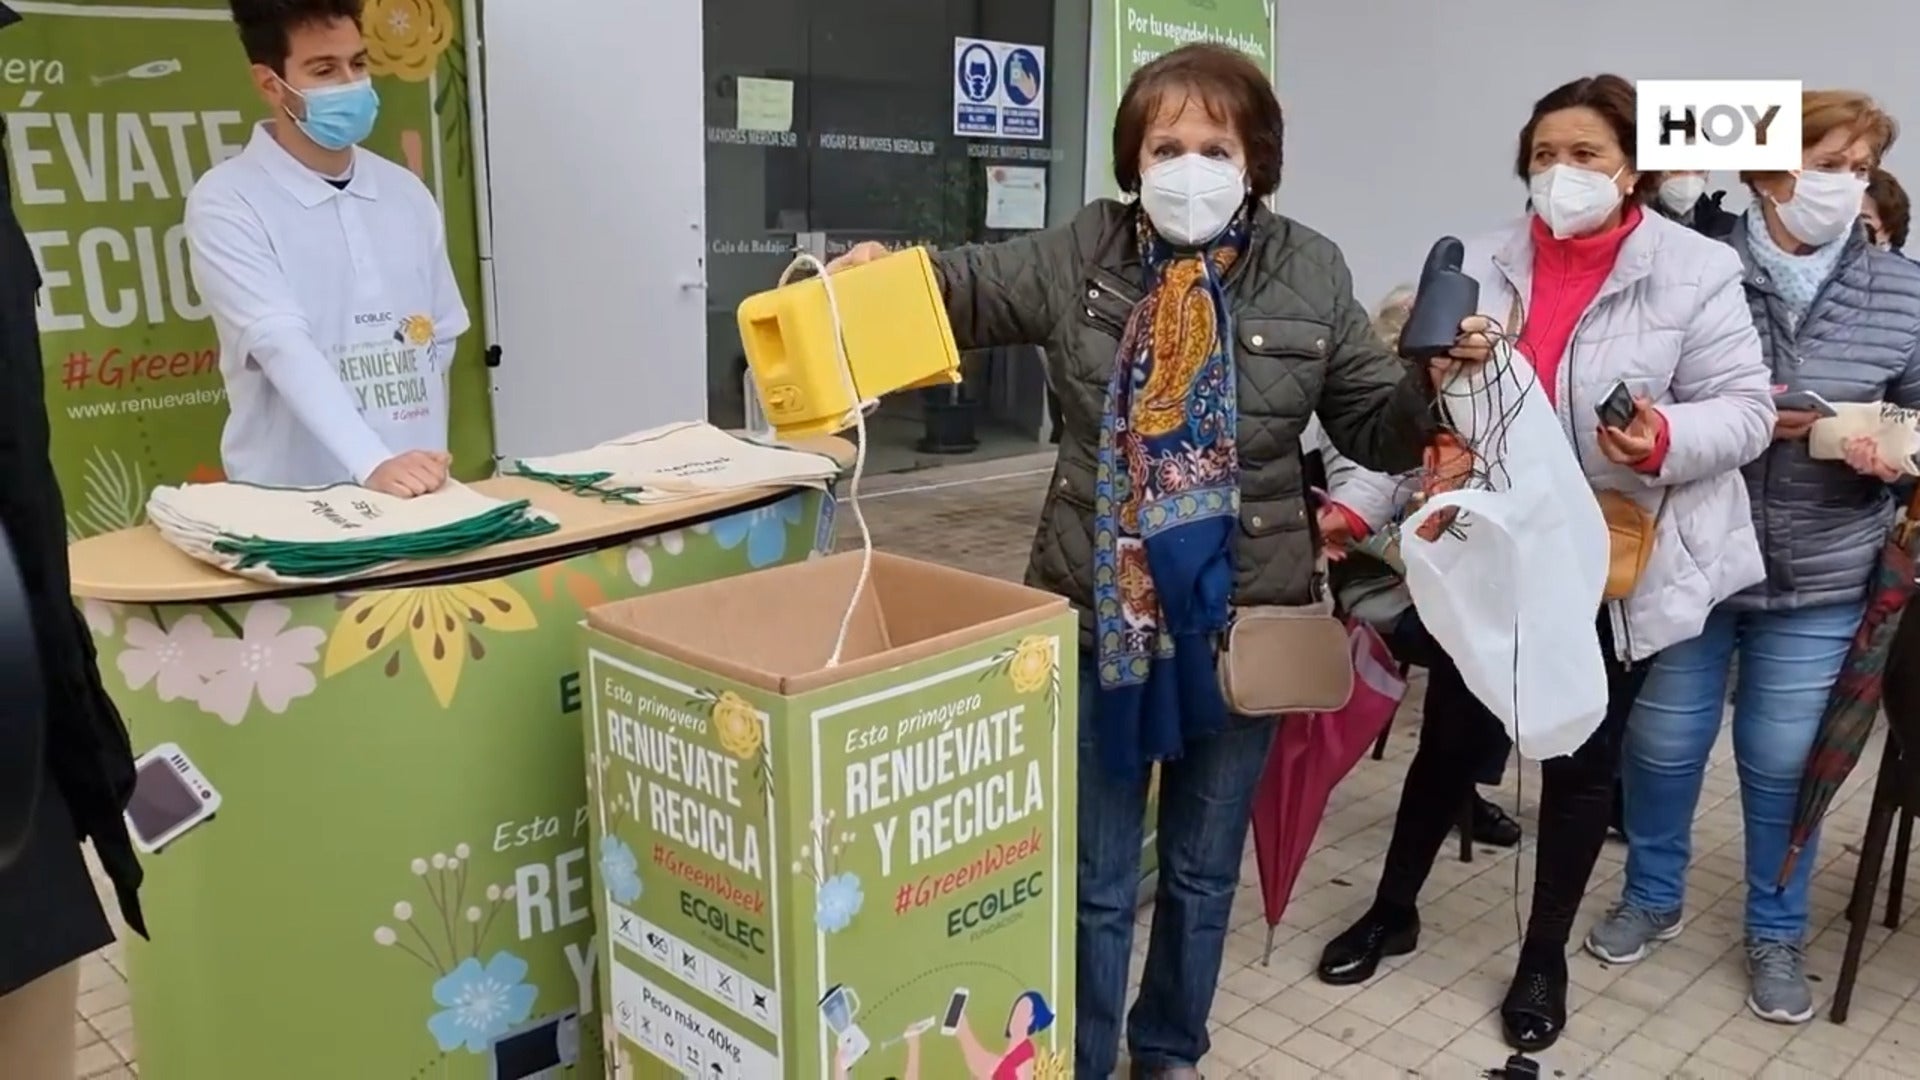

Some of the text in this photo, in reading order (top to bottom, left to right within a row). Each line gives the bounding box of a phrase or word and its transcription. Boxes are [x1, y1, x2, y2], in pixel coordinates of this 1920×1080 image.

[1128, 7, 1147, 33] Por
[1150, 13, 1162, 36] tu
[1164, 21, 1208, 45] seguridad
[6, 90, 243, 204] ÉVATE
[707, 127, 746, 144] MAYORES
[780, 131, 797, 147] SUR
[820, 133, 846, 149] HOGAR
[847, 135, 858, 150] DE
[859, 136, 892, 152] MAYORES
[921, 140, 935, 155] SUR
[712, 240, 735, 254] Caja
[736, 240, 750, 253] de
[354, 312, 392, 324] ECOLEC
[355, 385, 367, 410] Y
[604, 677, 708, 735] Esta primavera
[845, 694, 982, 753] Esta primavera
[607, 708, 742, 808] RENUÉVATE
[846, 704, 1025, 819] RENUÉVATE
[493, 815, 560, 851] Esta
[626, 770, 762, 880] Y RECICLA
[873, 759, 1043, 877] Y RECICLA
[515, 847, 590, 940] RE
[652, 842, 764, 916] #GreenWeek
[895, 826, 1042, 917] #GreenWeek
[947, 870, 1043, 938] ECOLEC
[680, 891, 766, 955] ECOLEC
[564, 934, 598, 1016] Y
[642, 987, 741, 1063] Peso máx. 40kg
